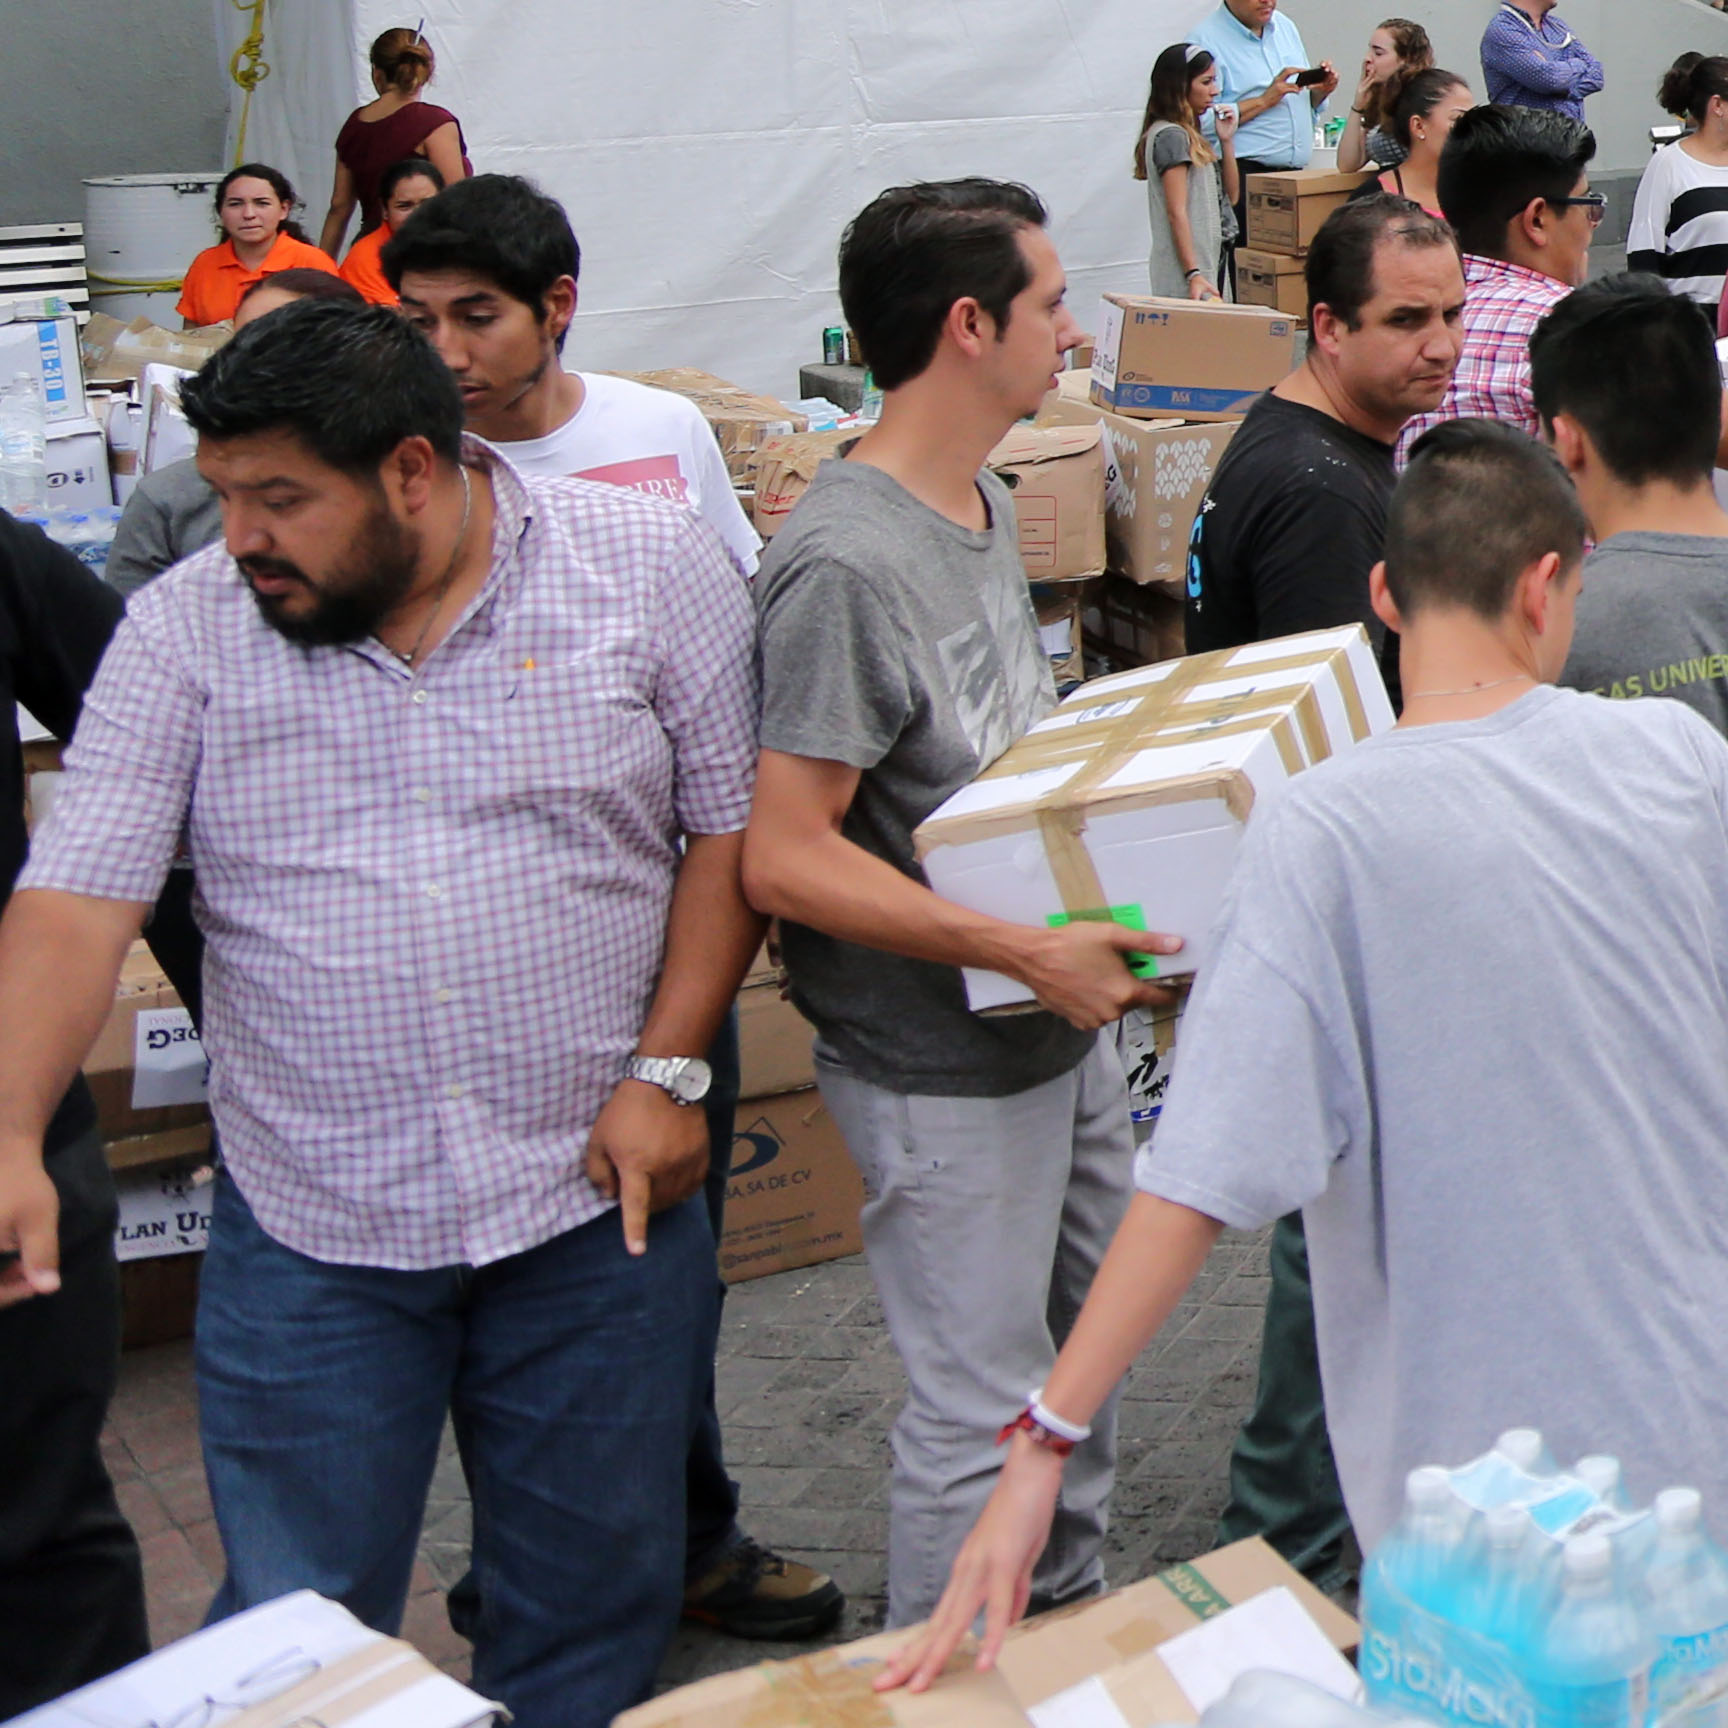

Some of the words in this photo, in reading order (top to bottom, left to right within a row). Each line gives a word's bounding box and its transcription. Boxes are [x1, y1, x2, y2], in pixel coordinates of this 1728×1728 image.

[769, 1176, 788, 1190] DE
[791, 1170, 812, 1185] CV
[120, 1222, 167, 1241] LAN
